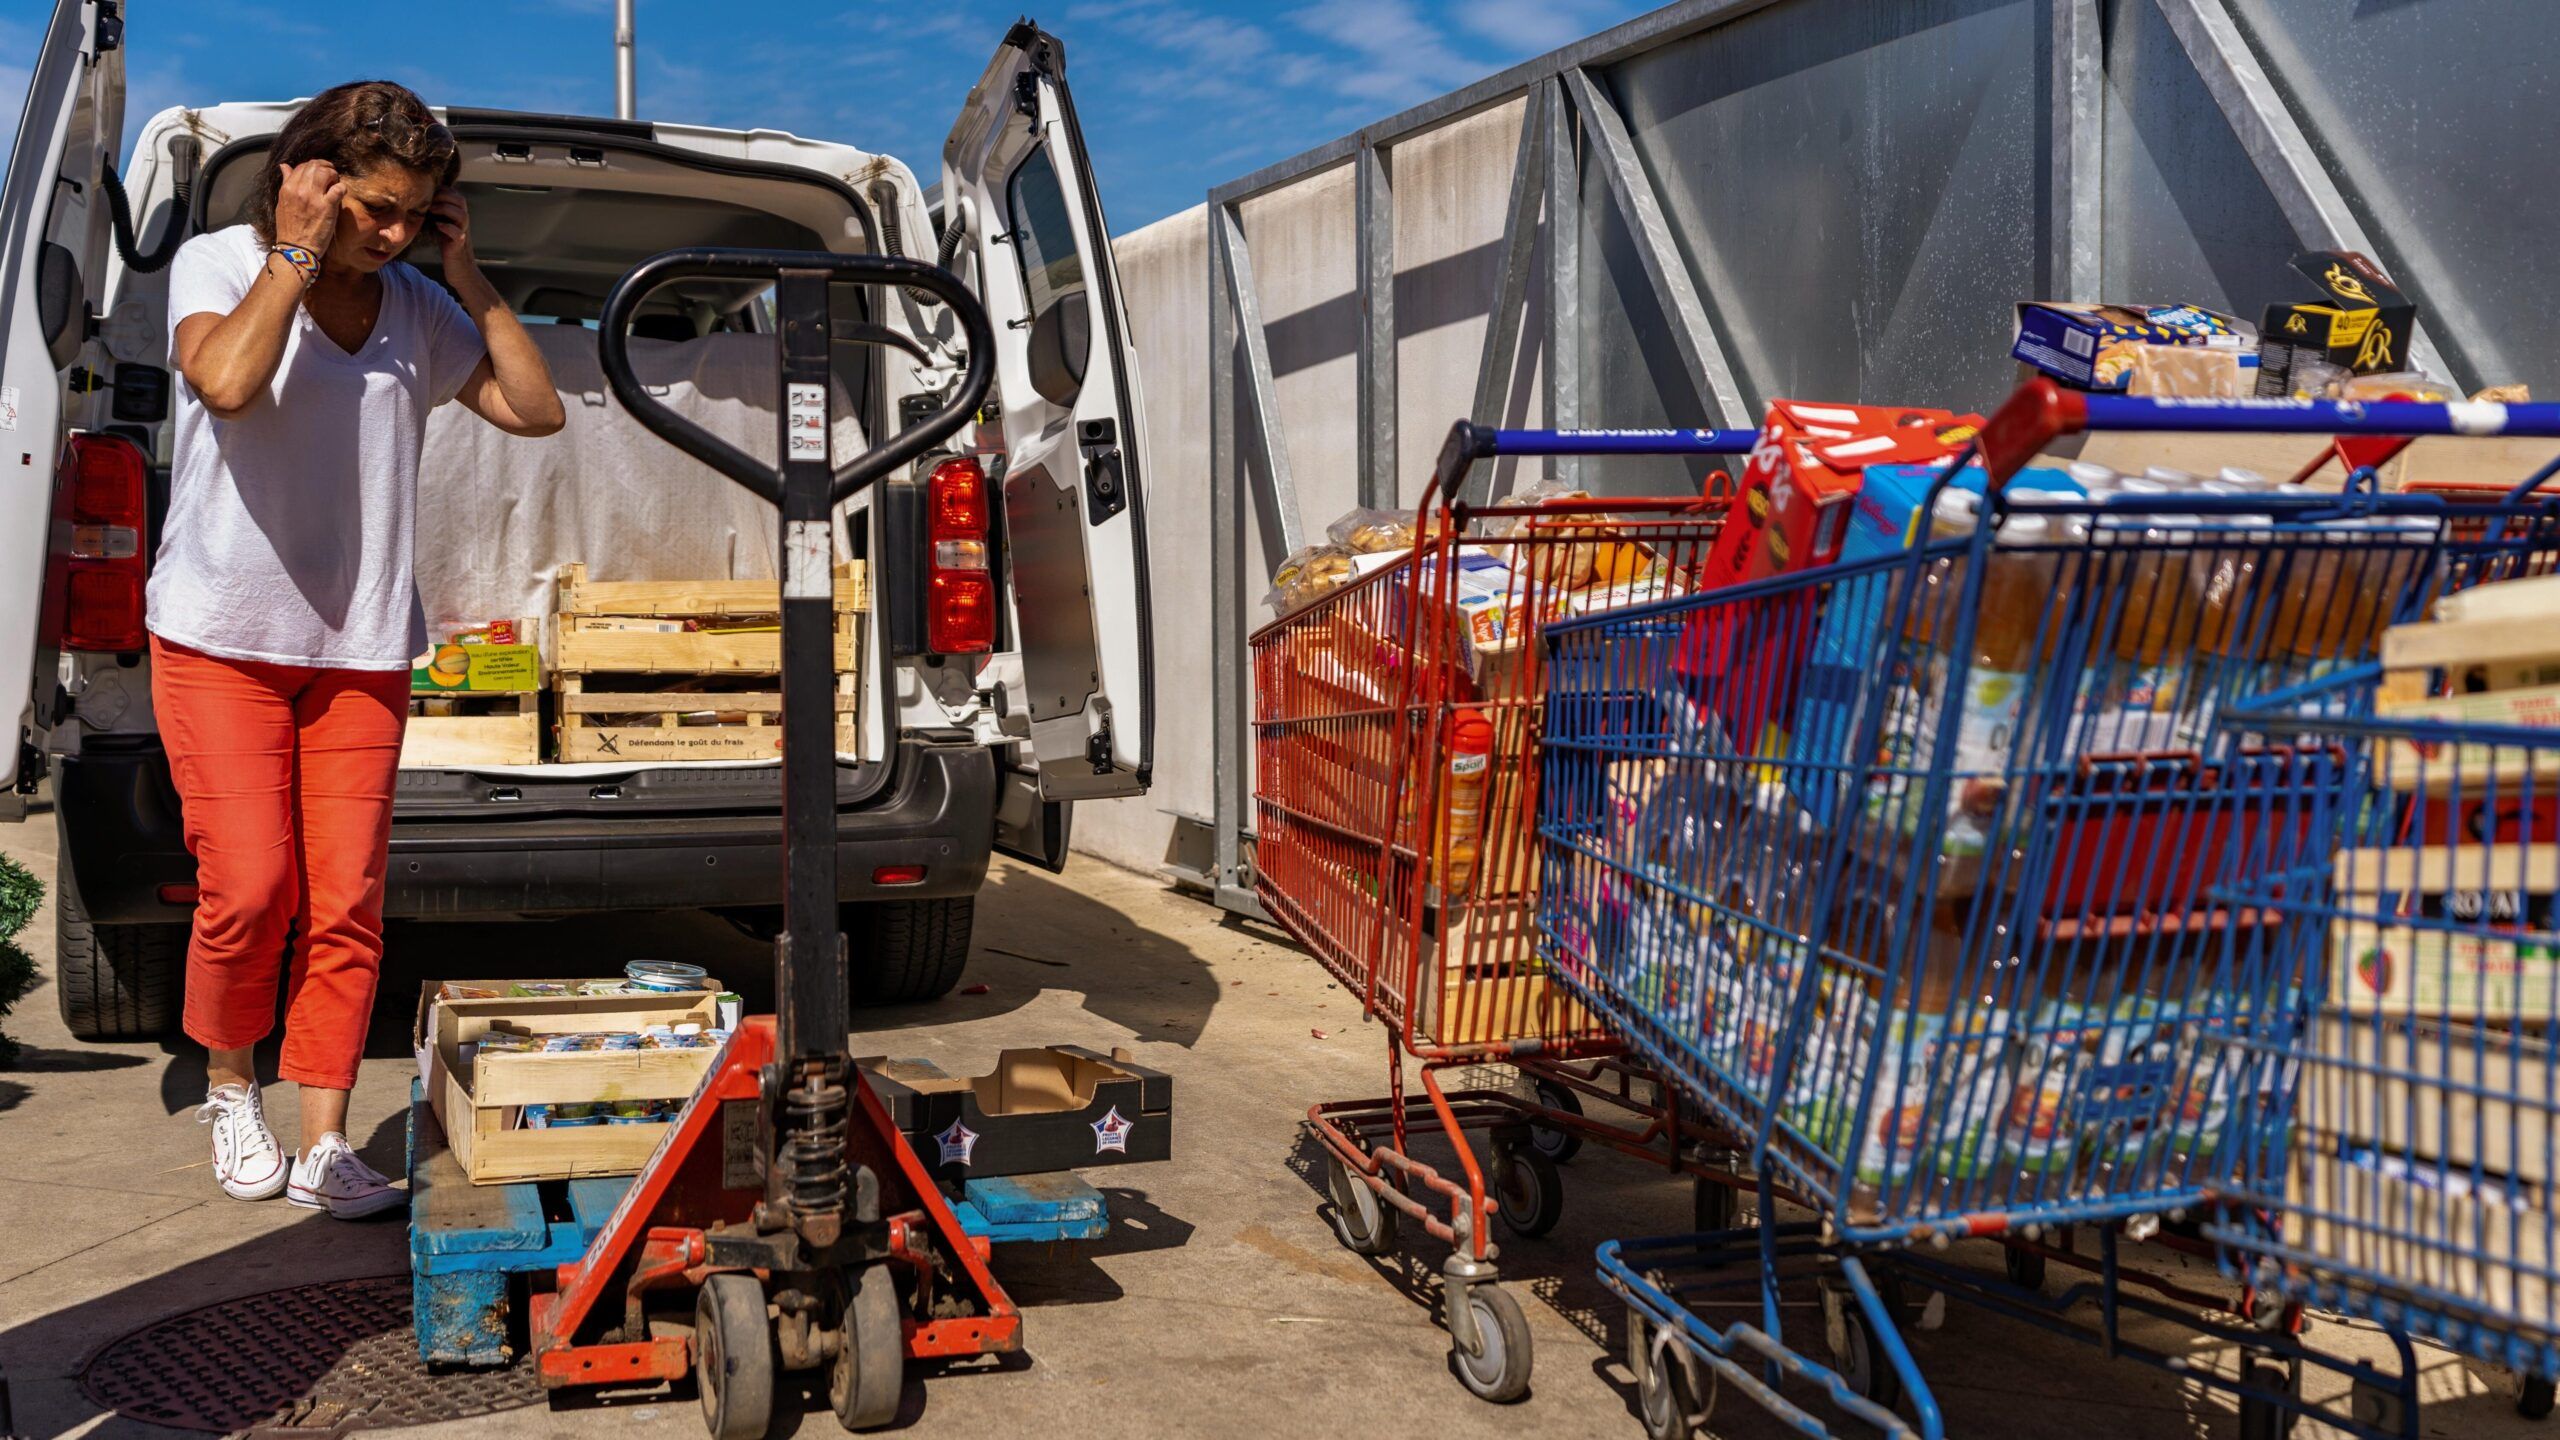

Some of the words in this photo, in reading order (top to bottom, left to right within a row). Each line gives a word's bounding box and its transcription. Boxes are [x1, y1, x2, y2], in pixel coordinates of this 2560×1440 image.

[2337, 315, 2350, 331] 40
[628, 738, 674, 747] Défendons
[677, 738, 686, 746] le
[688, 737, 708, 748] goût
[710, 738, 722, 746] du
[724, 738, 744, 746] frais
